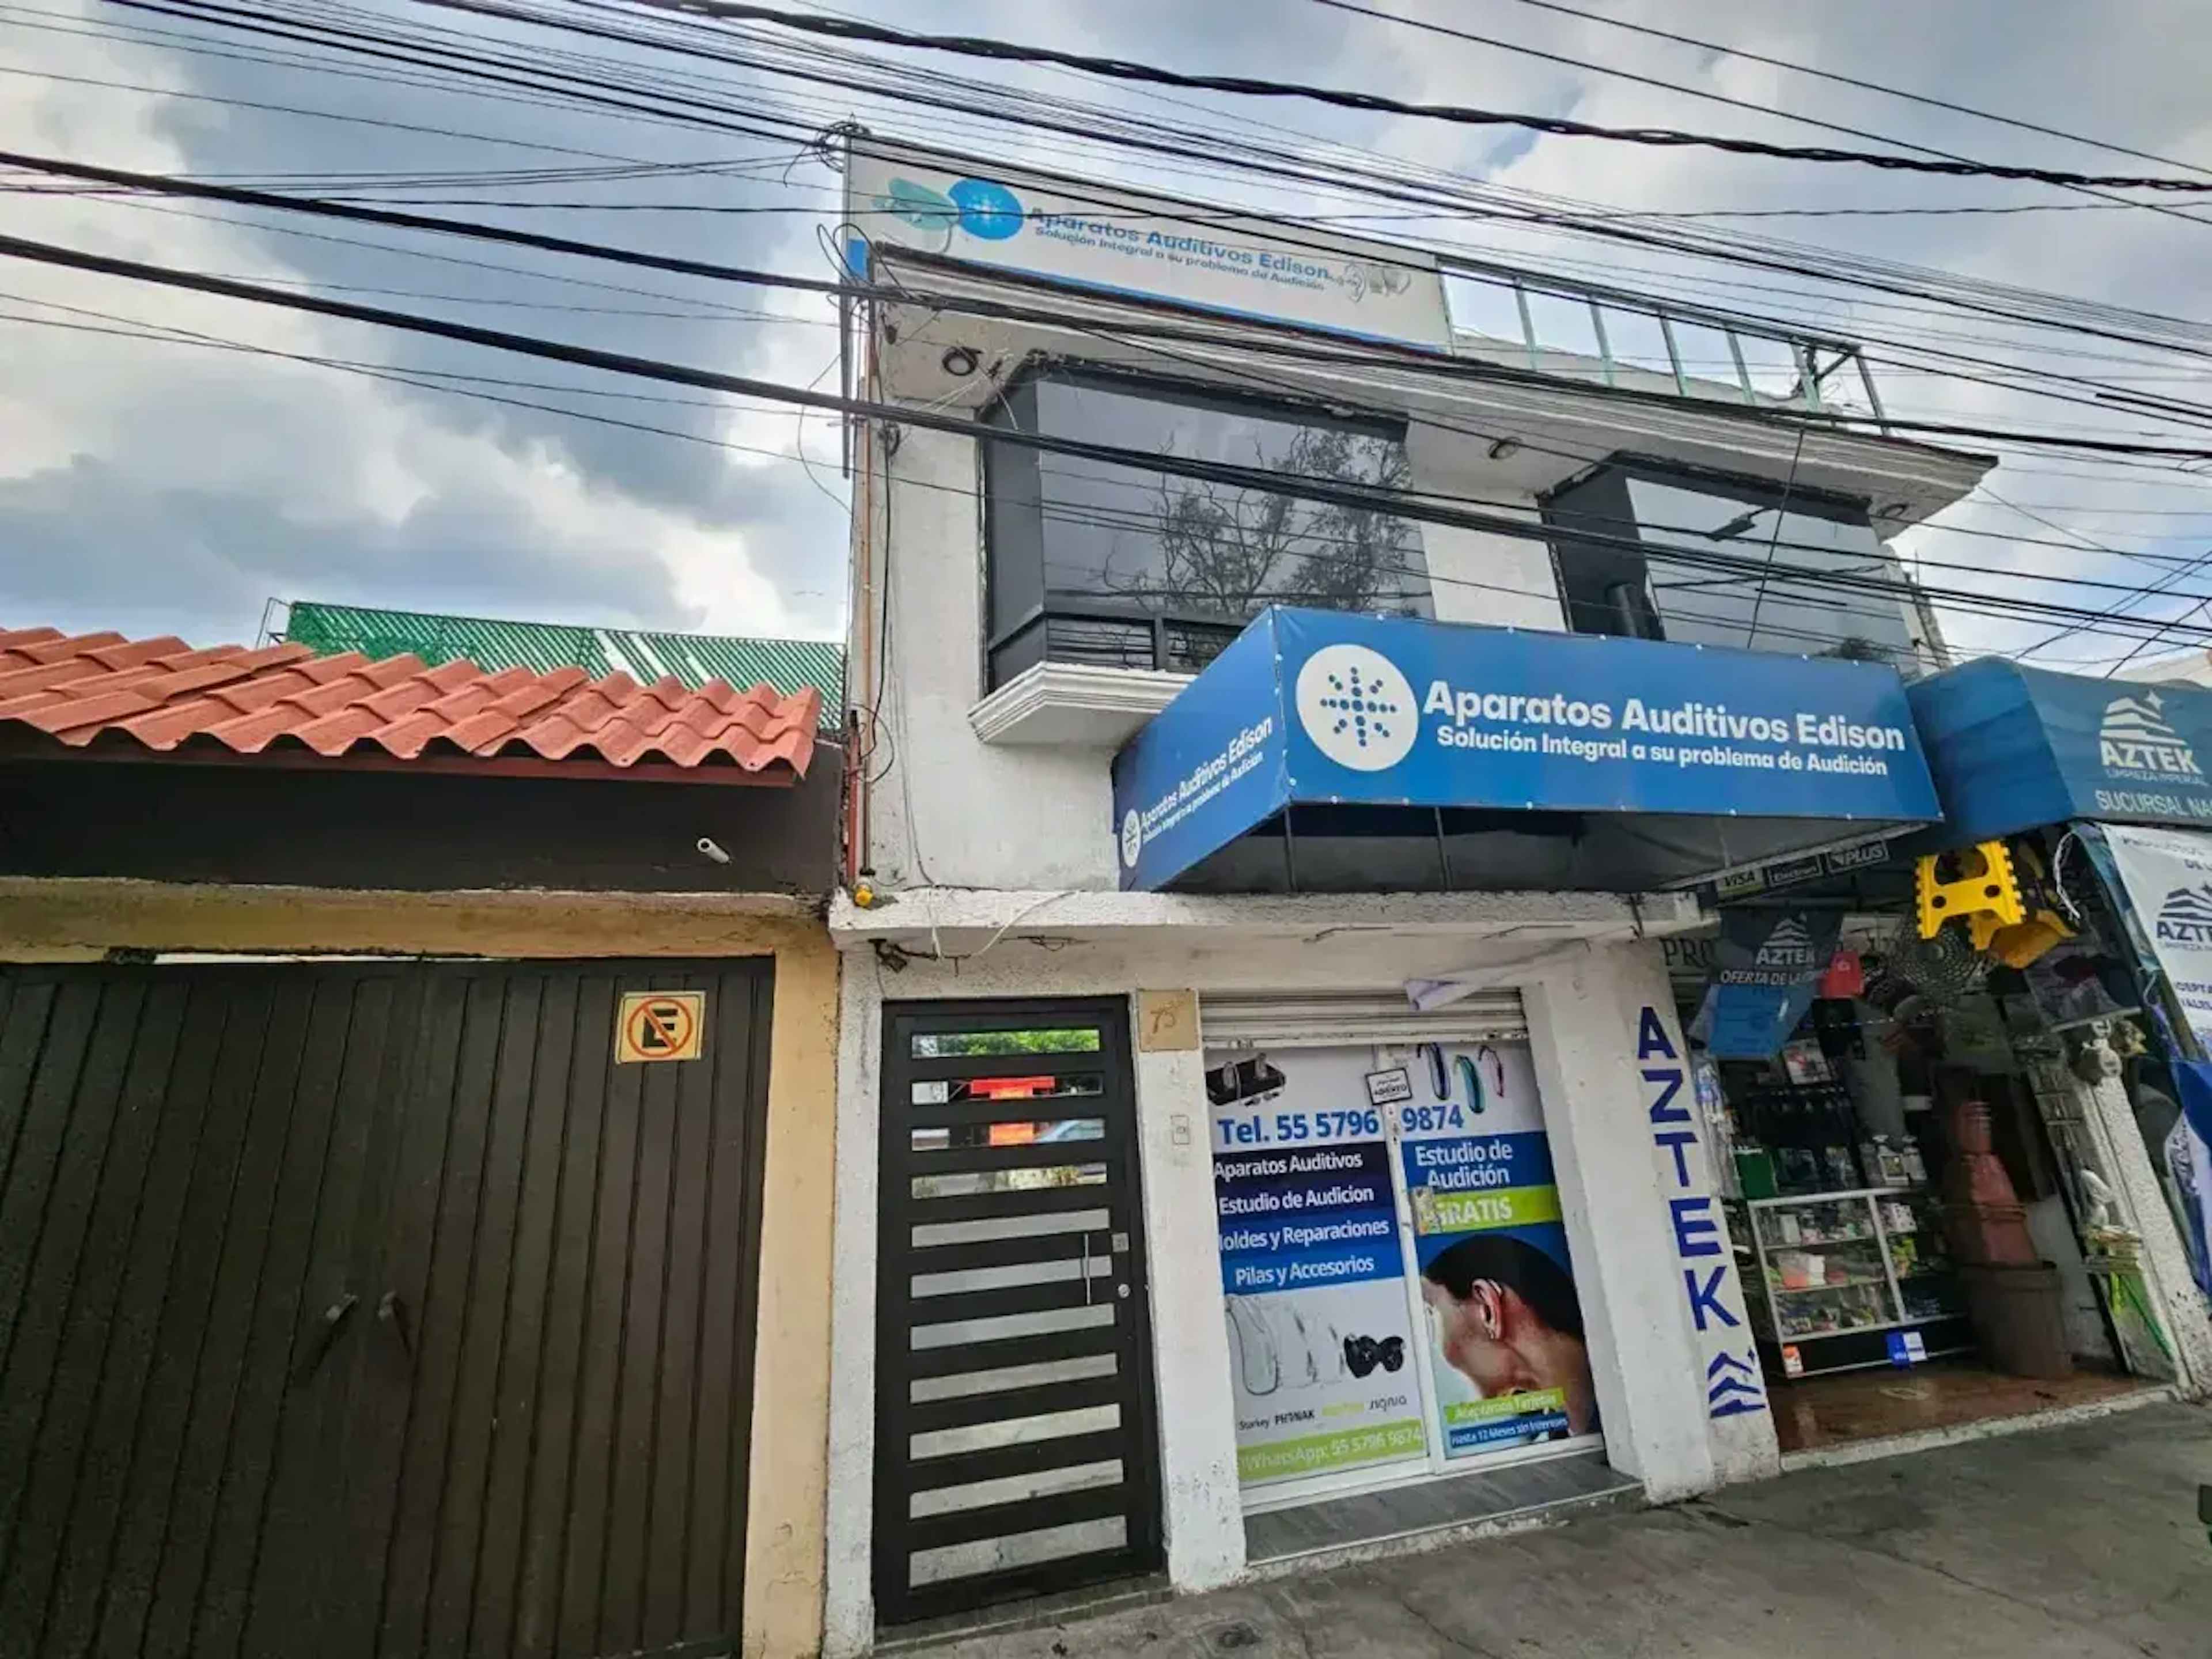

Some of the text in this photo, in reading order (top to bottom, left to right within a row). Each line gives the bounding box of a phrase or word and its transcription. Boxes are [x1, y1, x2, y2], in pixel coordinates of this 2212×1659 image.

[1027, 207, 1330, 279] Aparatos Auditivos Edison
[1423, 680, 1906, 751] Aparatos Auditivos Edison
[1437, 724, 1888, 776] Solución Integral a su problema de Audición
[2100, 739, 2203, 775] AZTEK
[2095, 788, 2189, 816] SUCURSAL
[1844, 844, 1884, 865] PLUS
[1724, 870, 1756, 887] VISA
[1217, 1104, 1464, 1145] Tel. 55 5796 9874
[1214, 1151, 1363, 1183] Aparatos Auditivos
[1415, 1138, 1513, 1166] Estudio de
[1427, 1163, 1510, 1190] Audición
[1637, 1006, 1741, 1331] AZTEK
[1219, 1193, 1281, 1216] Estudio
[1282, 1191, 1303, 1210] de
[1269, 1232, 1282, 1251] y
[1283, 1218, 1389, 1247] Reparaciones
[1236, 1255, 1375, 1287] Pilas y Accesorios
